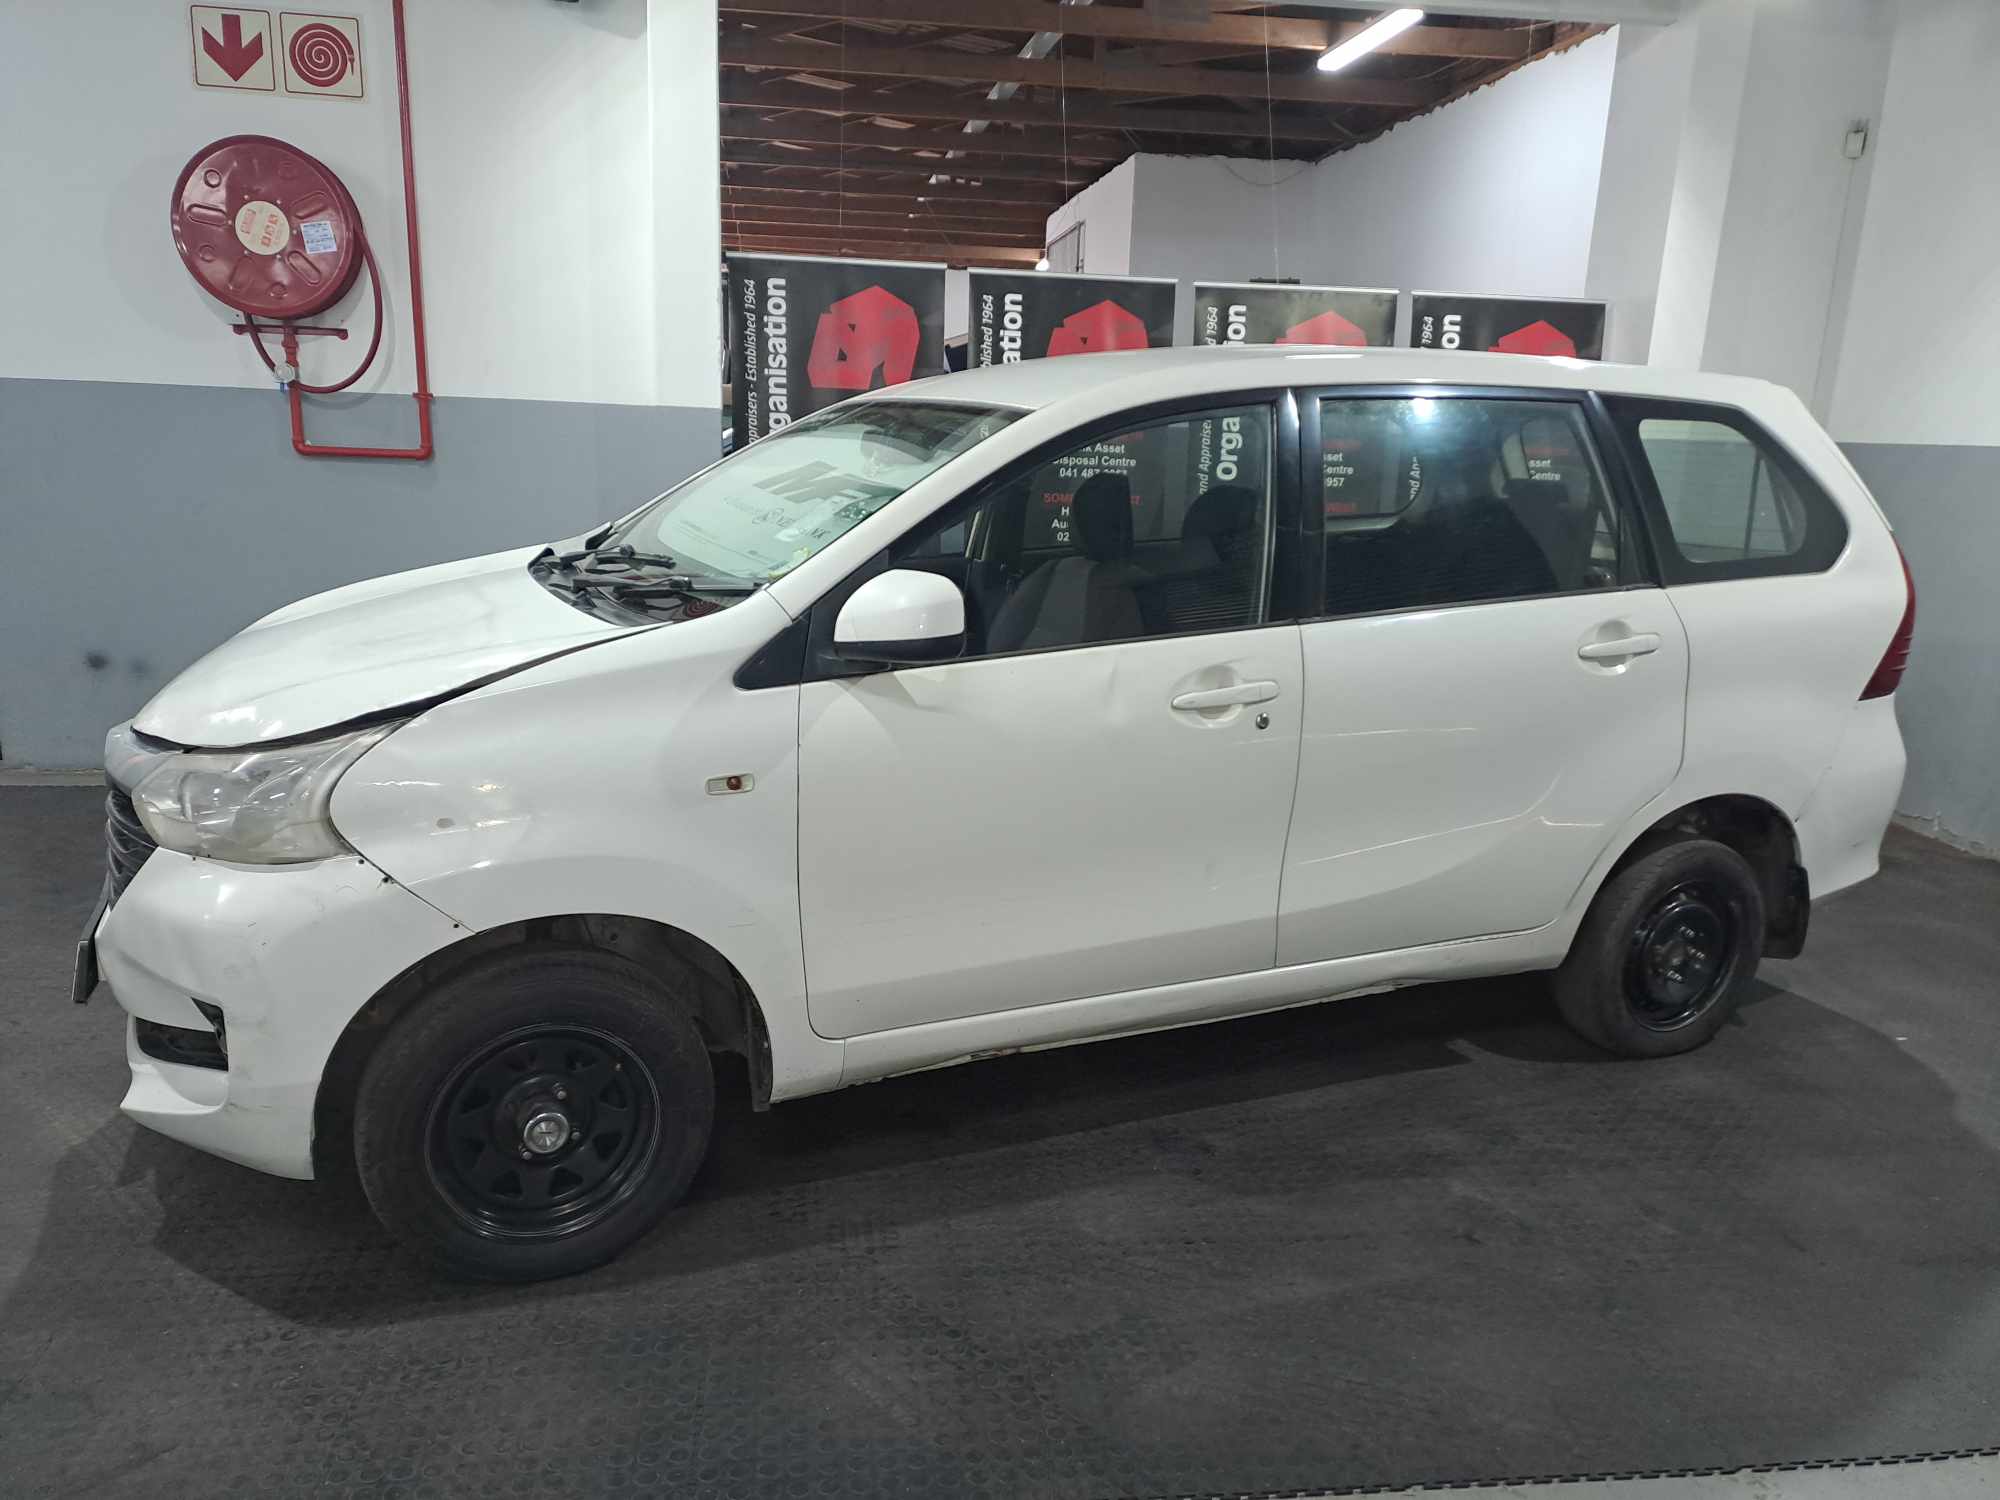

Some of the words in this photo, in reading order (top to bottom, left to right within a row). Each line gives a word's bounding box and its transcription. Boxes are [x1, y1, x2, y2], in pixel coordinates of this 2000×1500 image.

[743, 279, 756, 309] 1964
[982, 294, 993, 324] 1964
[1207, 306, 1218, 335] 1964
[1421, 315, 1434, 344] 1964
[743, 311, 757, 381] Established
[763, 277, 791, 434] ganisation
[1094, 442, 1125, 454] Asset
[1101, 455, 1137, 467] Centre
[1216, 416, 1243, 481] Orga
[1059, 467, 1078, 478] 041
